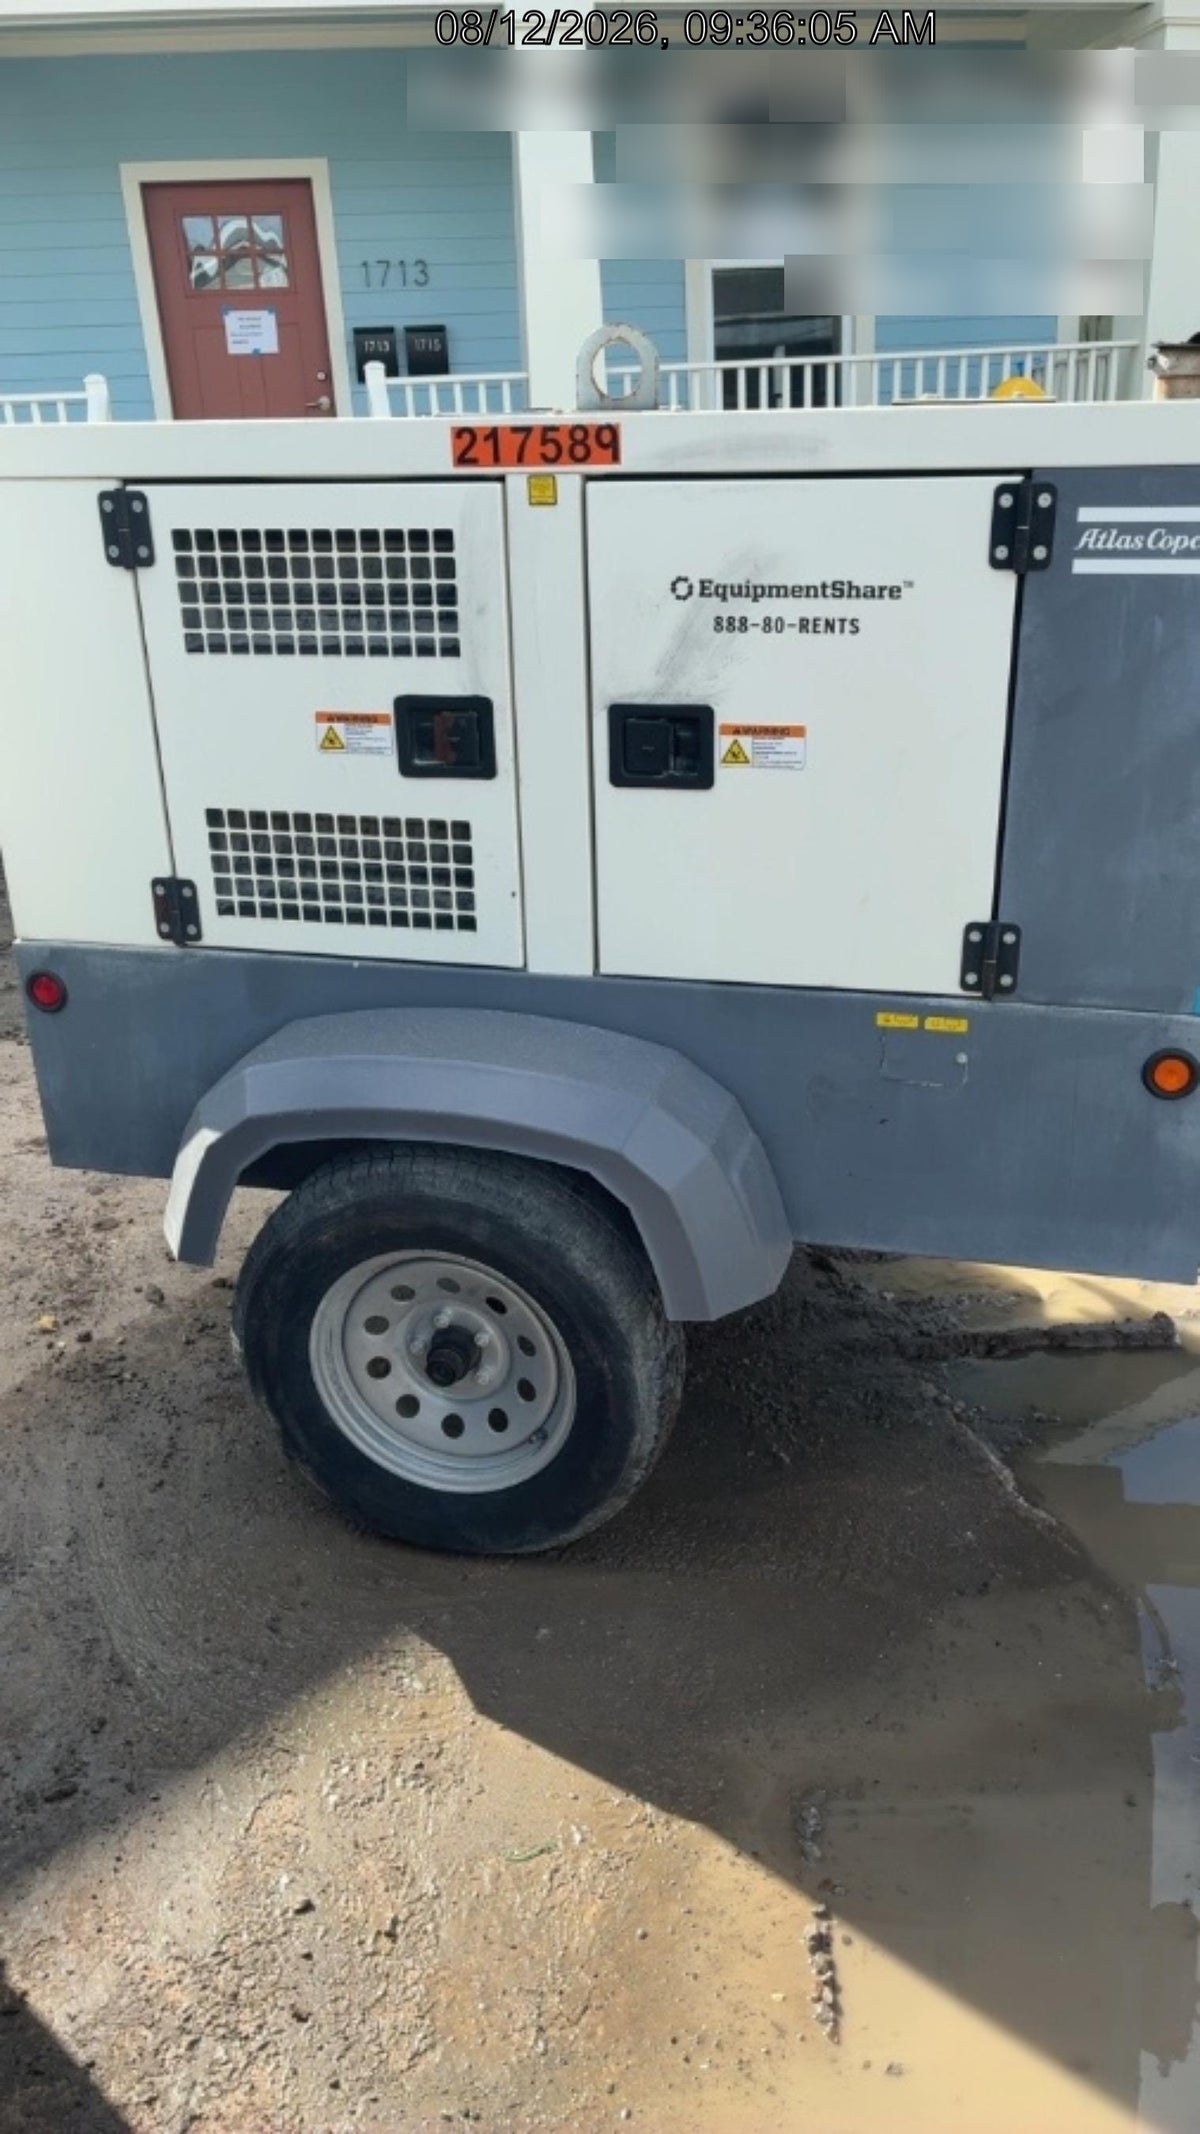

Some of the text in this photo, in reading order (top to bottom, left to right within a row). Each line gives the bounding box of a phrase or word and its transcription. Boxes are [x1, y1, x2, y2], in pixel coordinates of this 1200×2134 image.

[361, 259, 430, 288] 1713
[455, 423, 620, 465] 217589
[1073, 528, 1145, 551] Atlas
[713, 616, 860, 635] 888-80-RENTS
